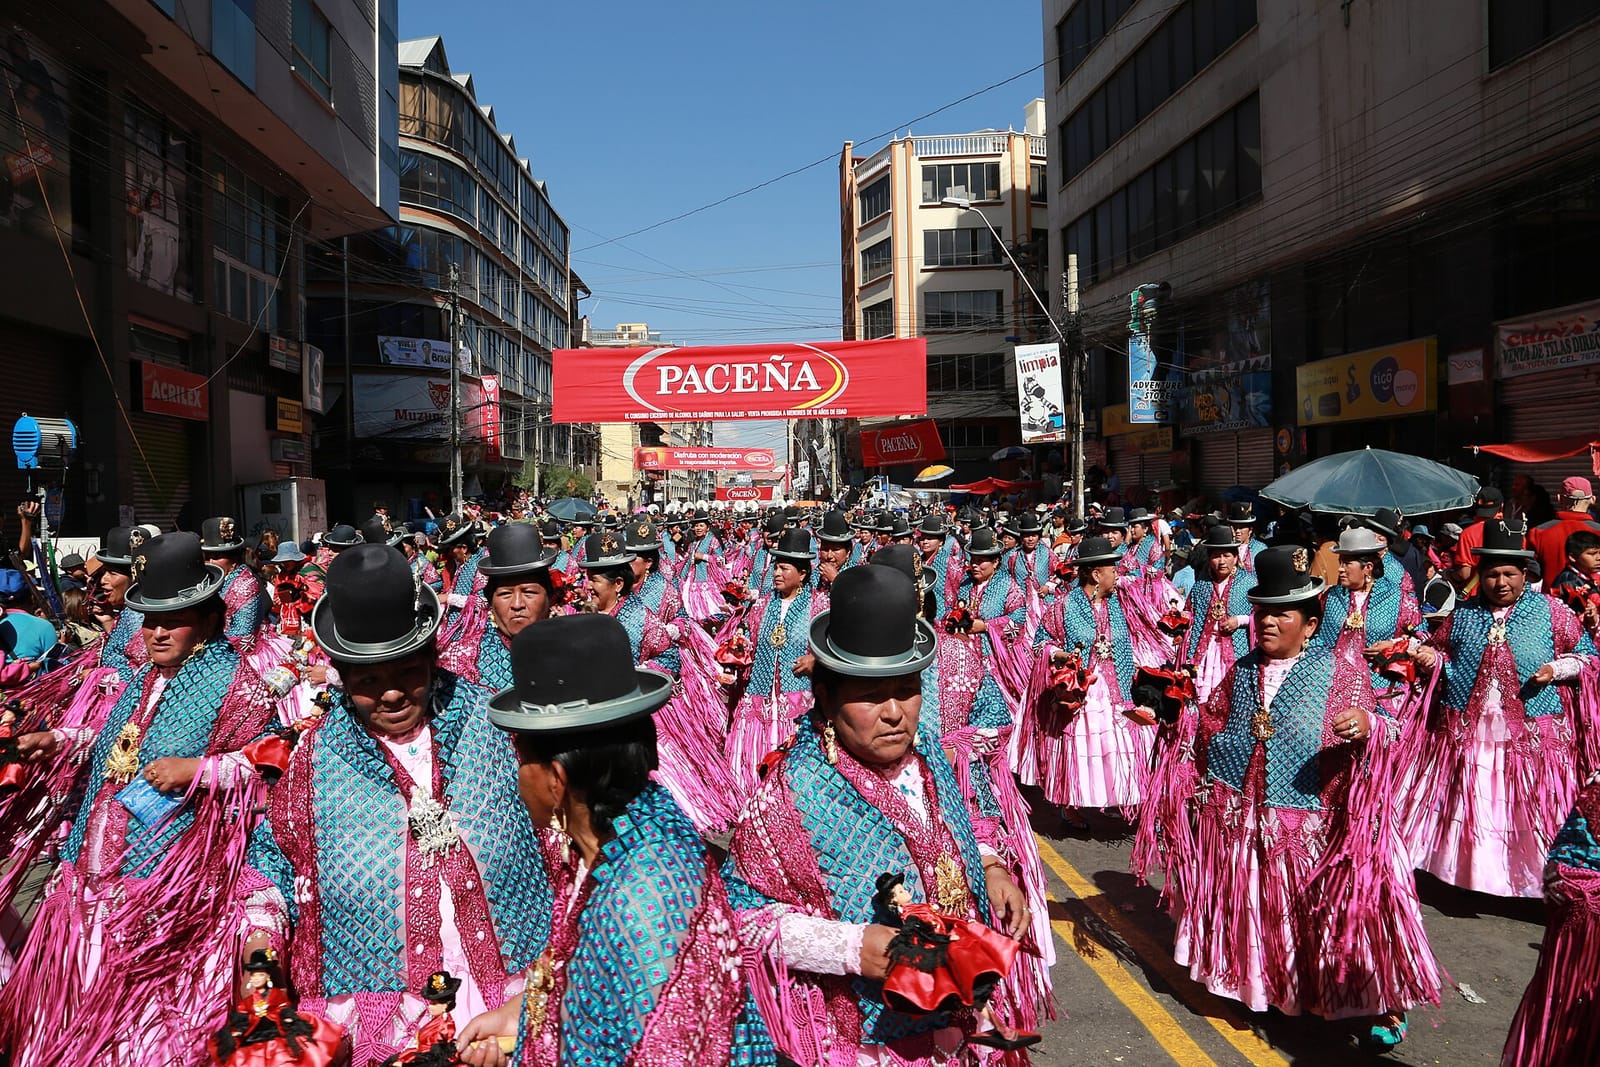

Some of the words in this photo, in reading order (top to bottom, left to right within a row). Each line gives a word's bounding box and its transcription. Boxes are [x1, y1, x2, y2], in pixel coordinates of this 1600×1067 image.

[1532, 344, 1544, 360] DE
[1544, 338, 1572, 357] TELAS
[1018, 354, 1058, 374] limpia
[656, 354, 823, 396] PACEÑA
[151, 379, 201, 409] ACRILEX
[1133, 381, 1182, 390] ADVENTURE
[1395, 384, 1416, 393] money
[881, 432, 918, 453] PACEÑA
[731, 489, 757, 498] PACEÑA
